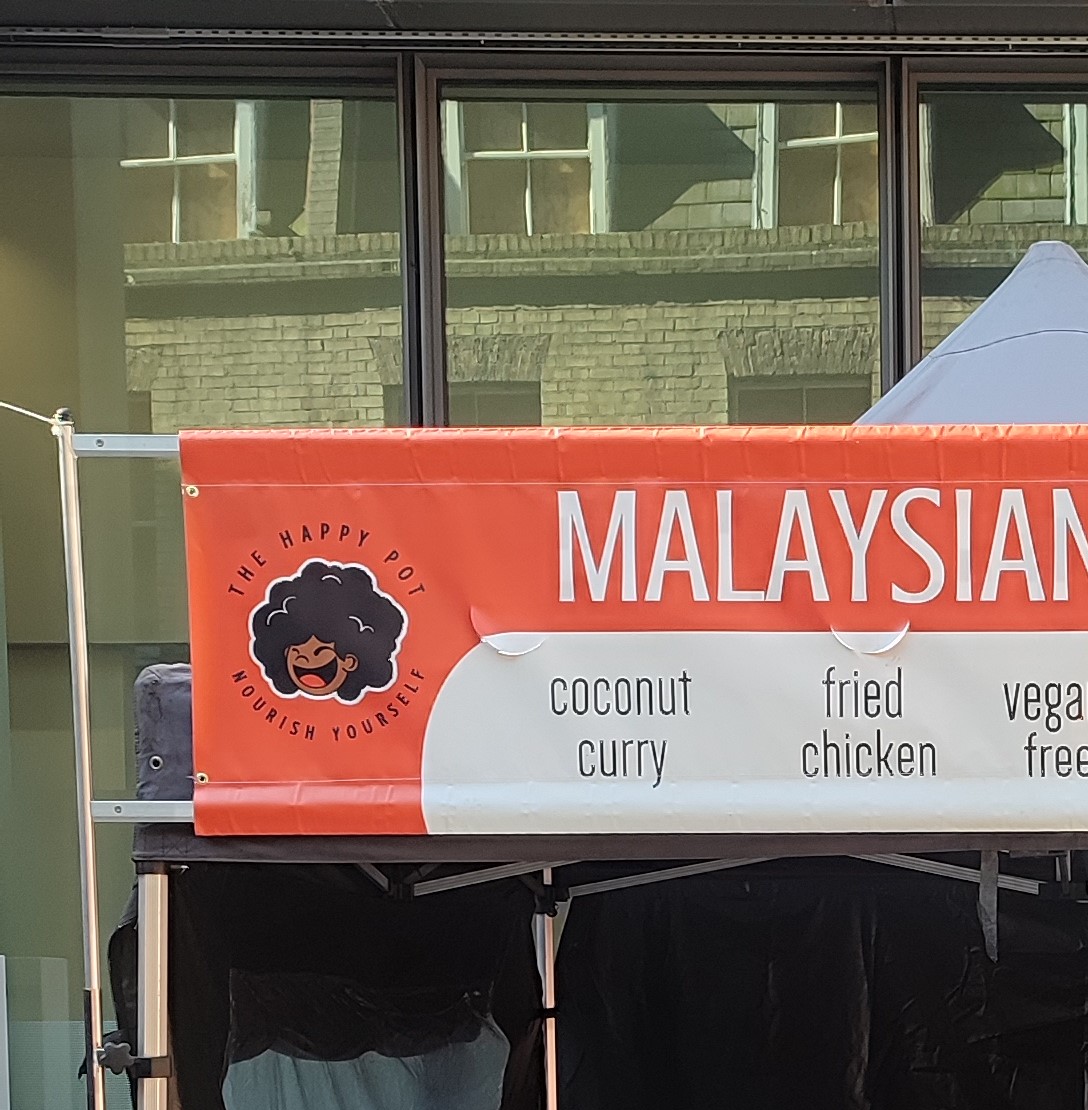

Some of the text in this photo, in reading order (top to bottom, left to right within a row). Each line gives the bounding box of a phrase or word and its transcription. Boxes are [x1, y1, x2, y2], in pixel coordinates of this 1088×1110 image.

[228, 522, 425, 596] THE HAPPY POT
[232, 668, 425, 741] NOURISH YOURSELF
[551, 670, 692, 716] coconut
[821, 666, 903, 719] fried
[578, 739, 668, 789] curry
[802, 729, 938, 778] chicken
